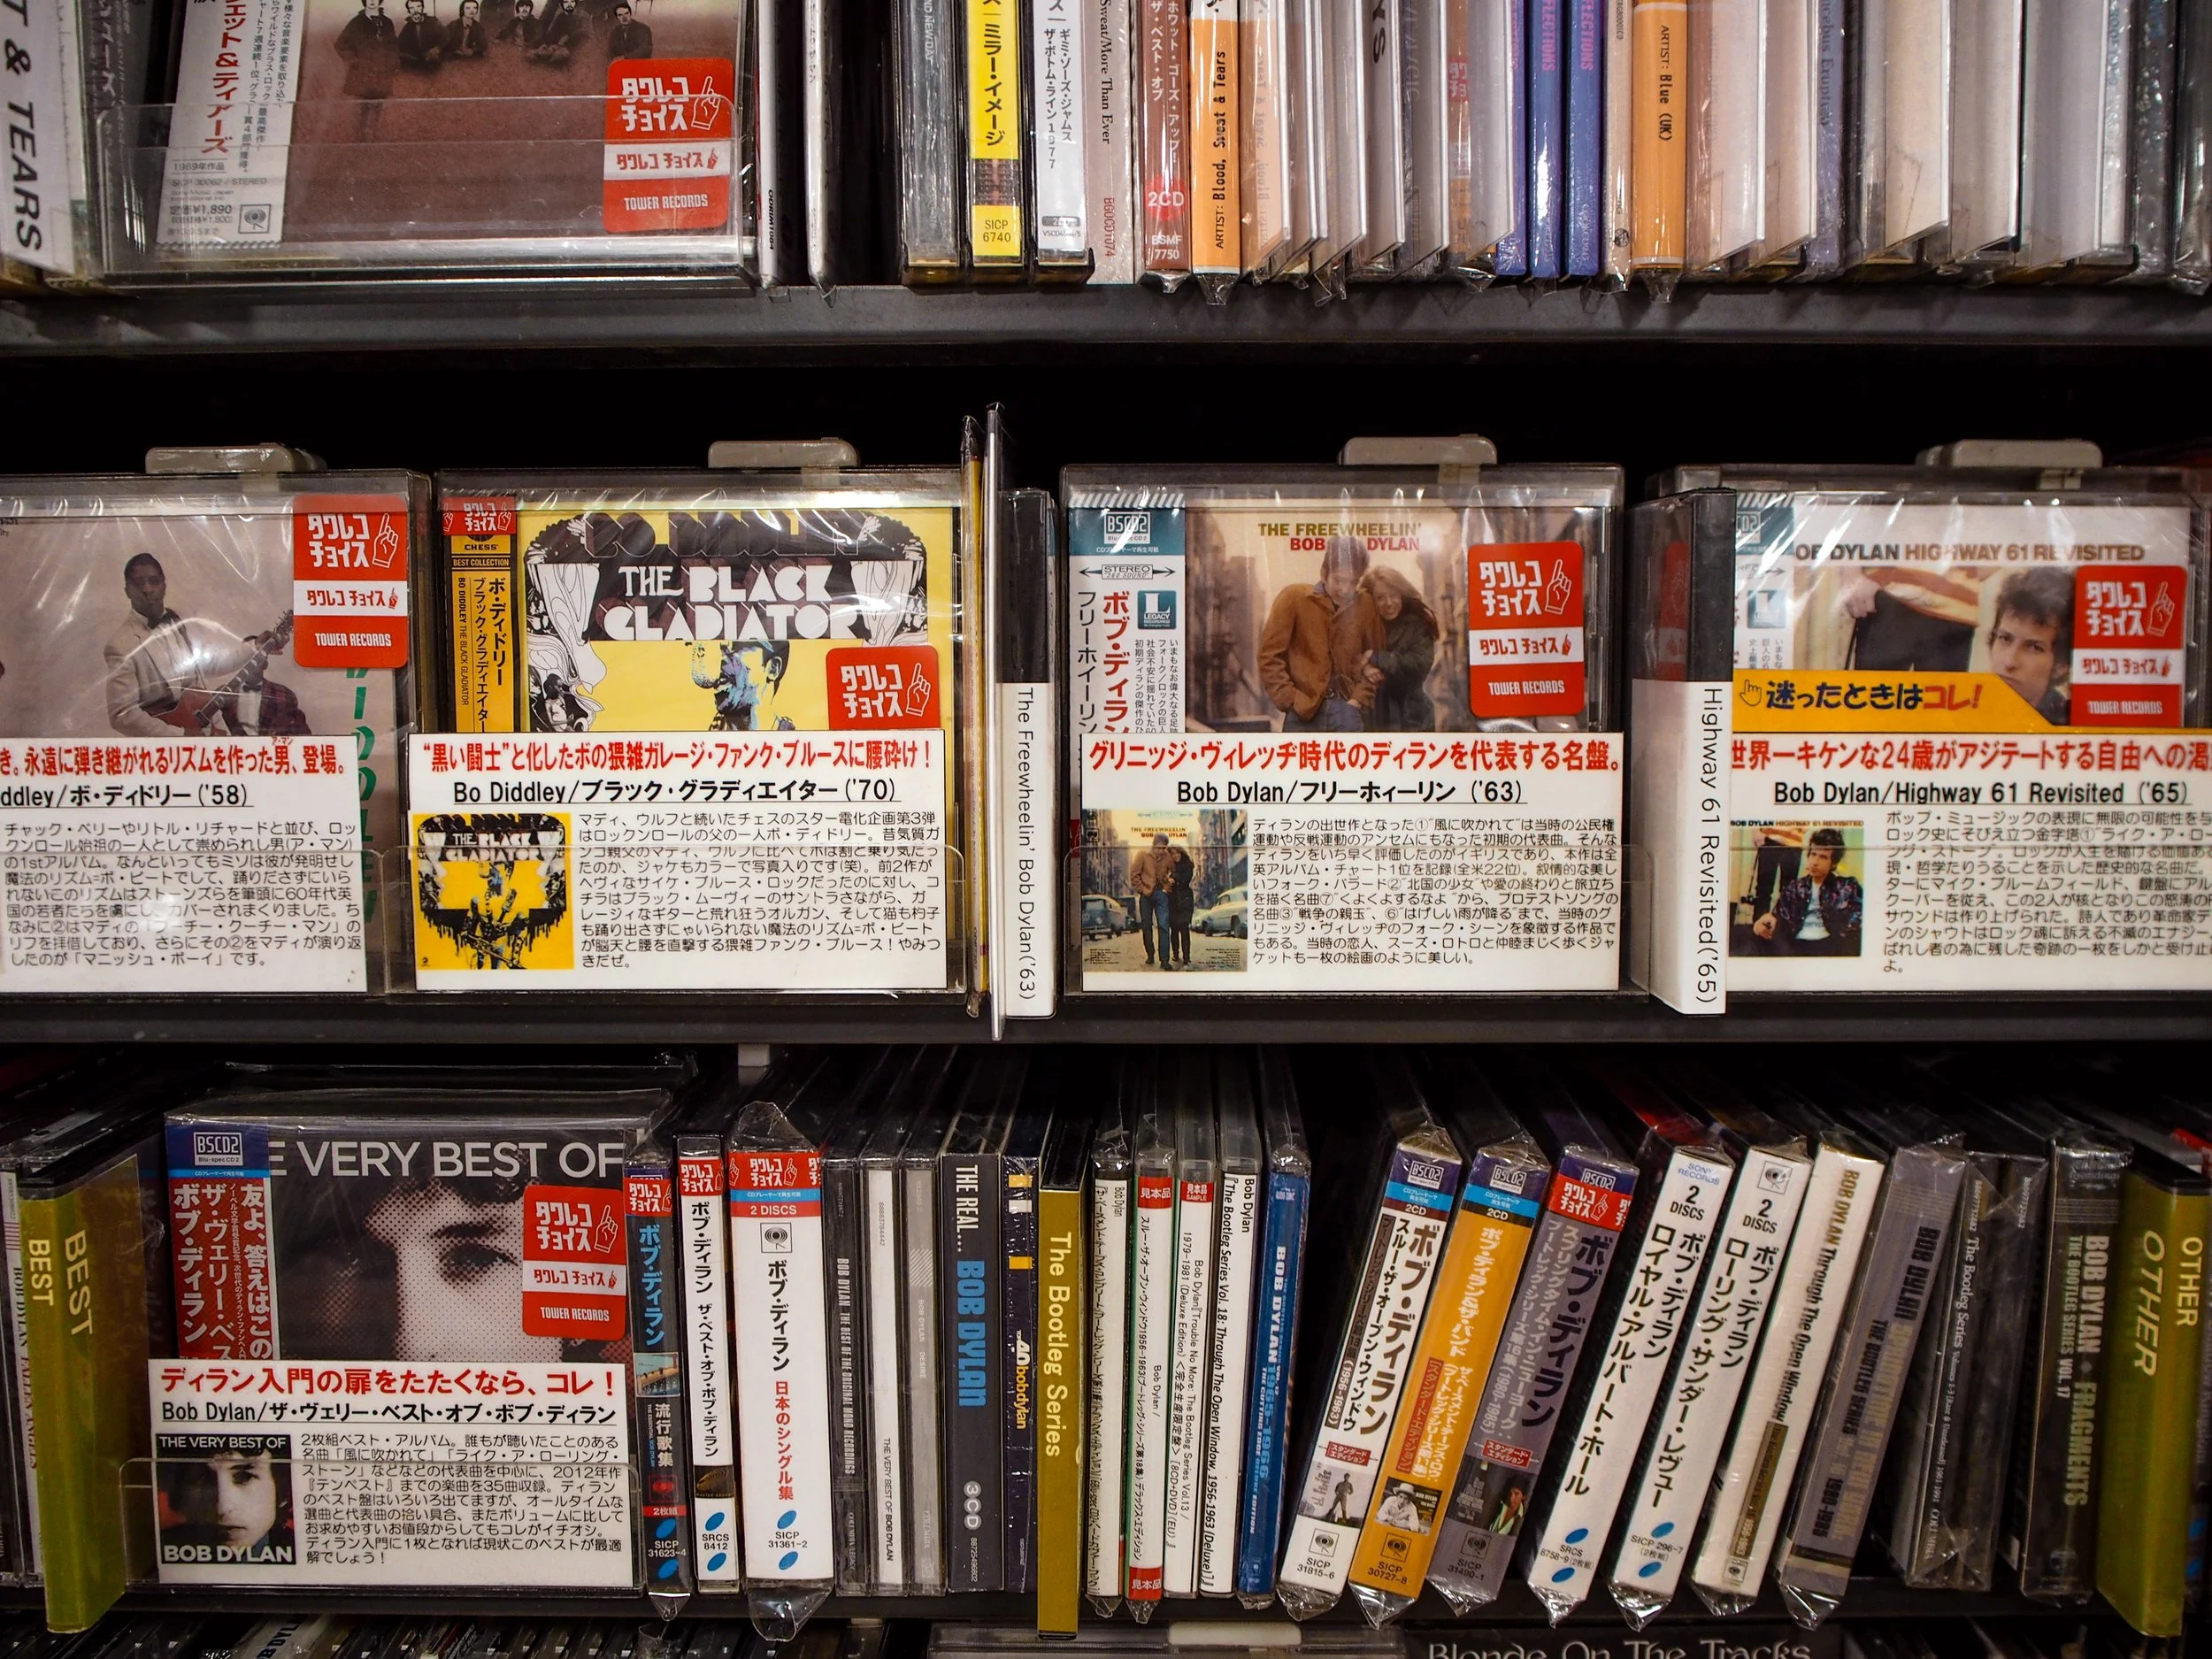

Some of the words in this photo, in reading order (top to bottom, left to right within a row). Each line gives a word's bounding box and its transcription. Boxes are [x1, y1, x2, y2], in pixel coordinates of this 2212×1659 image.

[4, 39, 31, 75] &
[1661, 25, 1670, 69] ARTIST:
[983, 23, 1005, 146] ミラー・イメージ
[1213, 51, 1225, 89] Tears
[621, 77, 689, 103] タワレコ
[1101, 78, 1112, 111] Than
[1660, 74, 1671, 104] Blue
[620, 104, 687, 131] チョイス
[1102, 114, 1113, 144] Ever
[1660, 112, 1672, 141] (UK)
[617, 154, 658, 170] タワレコ
[664, 152, 703, 168] チョイス
[8, 101, 42, 251] TEARS
[1213, 158, 1227, 201] Blood,
[624, 196, 659, 211] TOWER
[663, 194, 708, 208] RECORDS
[1148, 192, 1184, 207] 2CD
[982, 232, 1011, 242] 6740
[985, 219, 1008, 230] SICP
[1215, 205, 1225, 249] ARTIST:
[1154, 249, 1179, 260] 7750
[309, 513, 370, 539] タワレコ
[1258, 523, 1290, 536] THE
[309, 541, 369, 568] チョイス
[1290, 537, 1325, 550] BOB
[1367, 537, 1420, 551] DYLAN
[618, 565, 683, 600] THE
[688, 565, 833, 603] BLACK
[1479, 560, 1542, 588] タワレコ
[307, 590, 345, 606] タワレコ
[351, 590, 385, 606] チョイス
[1480, 589, 1542, 617] チョイス
[488, 577, 507, 686] ボ・ディドリー
[601, 603, 872, 641] GLADIATOR
[315, 633, 347, 647] TOWER
[350, 634, 392, 647] RECORDS
[840, 664, 903, 690] タワレコ
[1488, 682, 1520, 695] TOWER
[1523, 680, 1565, 695] RECORDS
[842, 692, 903, 718] チョイス
[1018, 687, 1033, 723] The
[1701, 688, 1723, 789] Highway
[454, 781, 480, 803] Bo
[1018, 730, 1035, 851] Freewheelin'
[1178, 780, 1217, 803] Bob
[1775, 781, 1814, 803] Bob
[1824, 780, 1982, 804] Dylan/Highway
[1992, 782, 2018, 803] 61
[2030, 782, 2124, 803] Revisited
[1701, 798, 1721, 825] 61
[1018, 859, 1034, 895] Bob
[1696, 834, 1720, 1002] Revisited('65)
[582, 955, 631, 968] きだぜ。
[1883, 959, 1903, 973] よ。
[196, 1134, 240, 1154] BSCD2
[296, 1141, 420, 1178] VERY
[433, 1141, 547, 1178] BEST
[559, 1142, 625, 1178] OF
[956, 1164, 979, 1193] THE
[1141, 1187, 1171, 1199] 見本品
[1243, 1179, 1255, 1200] Bob
[1404, 1203, 1426, 1216] 2CD
[1686, 1186, 1700, 1204] 2
[1758, 1199, 1773, 1217] 2
[750, 1206, 757, 1215] 2
[760, 1205, 797, 1215] DISCS
[1241, 1202, 1253, 1233] Dylan
[1486, 1207, 1509, 1220] 2CD
[1671, 1202, 1704, 1220] DISCS
[1742, 1215, 1778, 1233] DISCS
[691, 1201, 713, 1294] ボブ・ディラン
[1049, 1232, 1071, 1276] The
[2081, 1235, 2109, 1280] BOB
[28, 1239, 54, 1306] BEST
[173, 1184, 207, 1344] ボブ・ディラン
[65, 1229, 93, 1336] BEST
[638, 1224, 664, 1347] ボブ・ディラン
[956, 1261, 986, 1315] BOB
[1643, 1233, 1706, 1359] ボブ・ディラン
[2176, 1236, 2204, 1327] OTHER
[767, 1259, 790, 1371] ボブ・ディラン
[1720, 1246, 1779, 1369] ボブ・ディラン
[2134, 1230, 2166, 1376] OTHER
[1043, 1286, 1071, 1376] Bootleg
[1358, 1221, 1440, 1439] ボブ・ディラン
[1520, 1231, 1613, 1433] ボブ・ディラン
[2076, 1284, 2105, 1354] DYLAN
[957, 1322, 987, 1407] DYLAN
[1564, 1224, 1677, 1496] ロイヤル・アルバート・ホール
[1652, 1237, 1749, 1508] ローリング・サンダー・レヴュー
[162, 1402, 197, 1421] Bob
[1046, 1384, 1068, 1457] Series
[159, 1436, 187, 1448] THE
[188, 1437, 227, 1448] VERY
[229, 1437, 265, 1448] BEST
[265, 1438, 287, 1448] OF
[655, 1403, 673, 1468] 流行歌集
[775, 1380, 794, 1501] 日本のシングル集
[2063, 1380, 2097, 1506] FRAGMENTS
[654, 1540, 679, 1549] SICP
[702, 1532, 729, 1542] SRCS
[775, 1531, 800, 1540] SICP
[1559, 1544, 1583, 1556] SRCS
[164, 1545, 212, 1563] BOB
[216, 1545, 293, 1563] DYLAN
[1305, 1556, 1331, 1570] SICP
